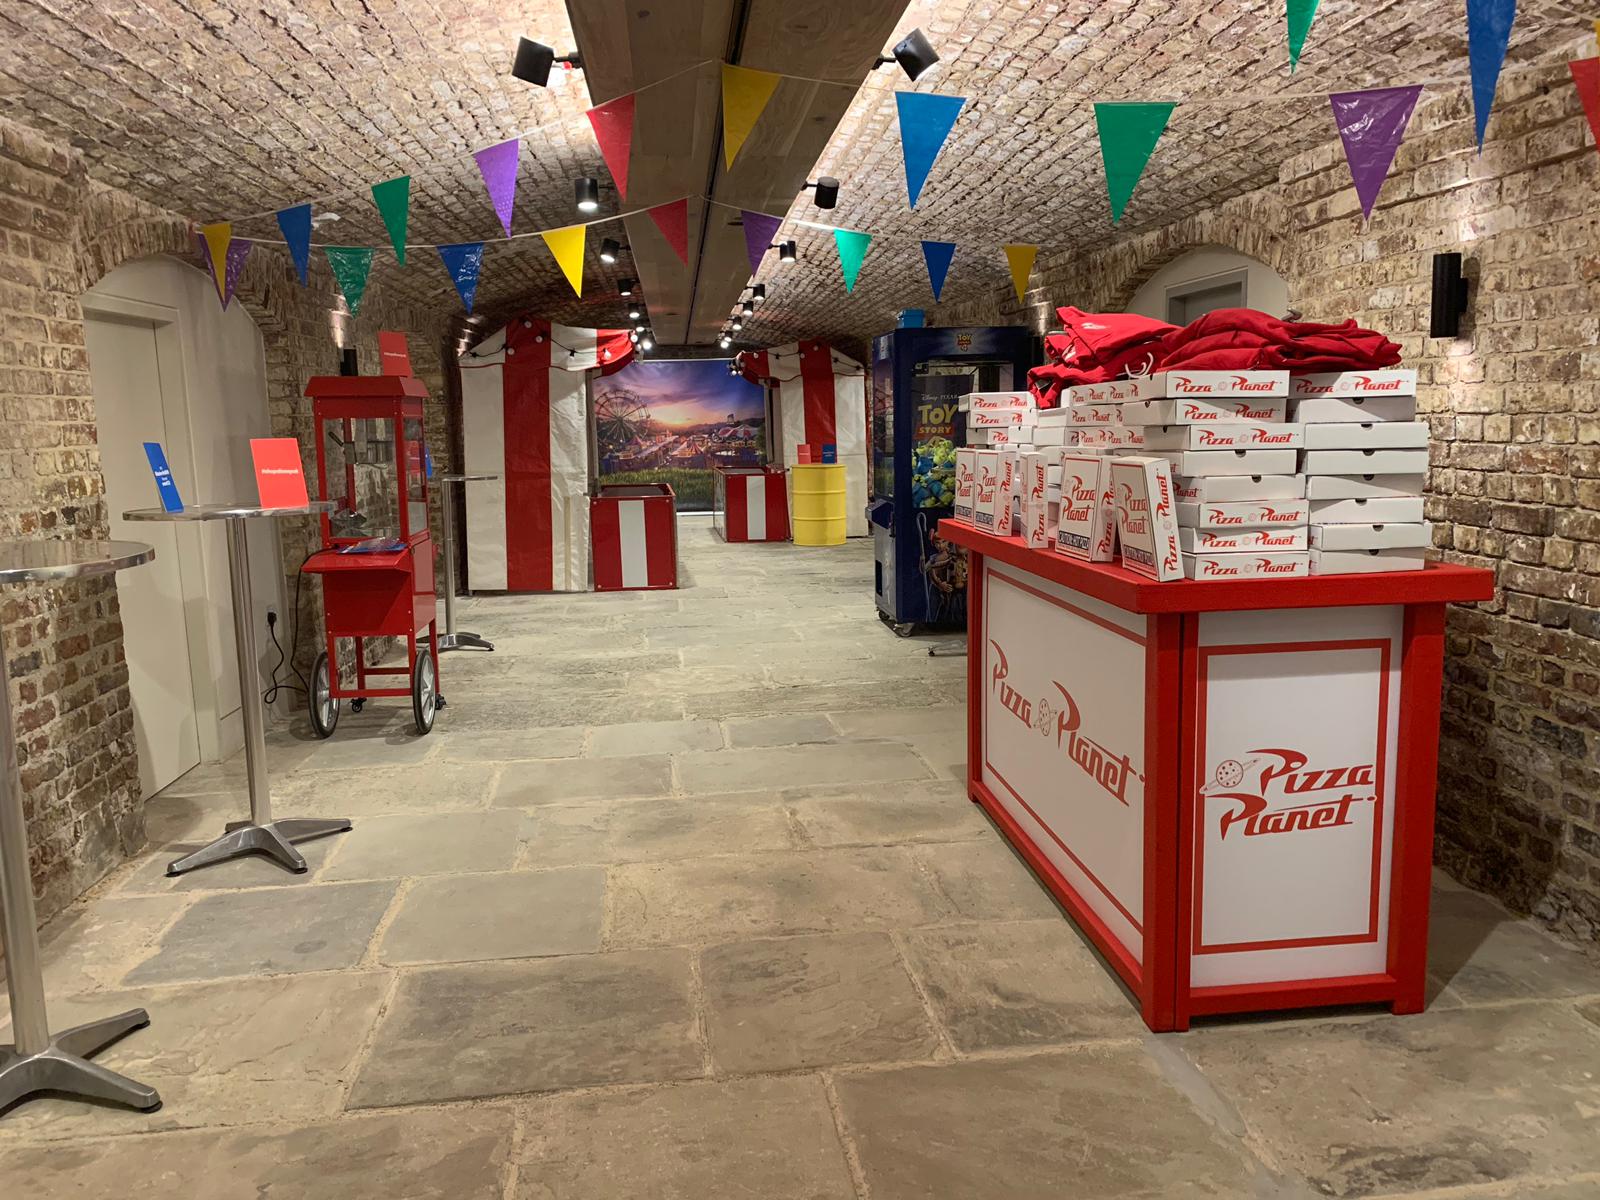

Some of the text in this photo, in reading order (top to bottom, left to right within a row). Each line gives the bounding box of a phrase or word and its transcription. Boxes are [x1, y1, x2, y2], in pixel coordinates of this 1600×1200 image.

[1173, 375, 1279, 392] Pizza Planet
[1295, 375, 1406, 393] Pizza Planet
[974, 396, 998, 408] Pizza
[1183, 403, 1218, 419] Pizza
[1234, 402, 1276, 418] Planet
[975, 413, 999, 424] Pizza
[919, 426, 952, 434] STORY
[1198, 427, 1294, 445] Pizza Planet
[1072, 475, 1095, 501] Pizza
[1121, 483, 1148, 512] Pizza
[1031, 463, 1045, 544] Pizza Planet
[1062, 496, 1094, 521] Planet
[1118, 506, 1149, 534] Planet
[1156, 474, 1178, 576] Pizza Planet
[1207, 507, 1301, 524] Pizza Planet
[1097, 522, 1113, 556] Pizza
[1200, 532, 1237, 547] Pizza
[1251, 530, 1297, 546] Planet
[1201, 560, 1239, 575] Pizza
[1255, 558, 1298, 573] Planet
[988, 638, 1144, 807] Pizza Planet
[1246, 748, 1375, 796] Pizza
[1205, 792, 1372, 841] Planet
